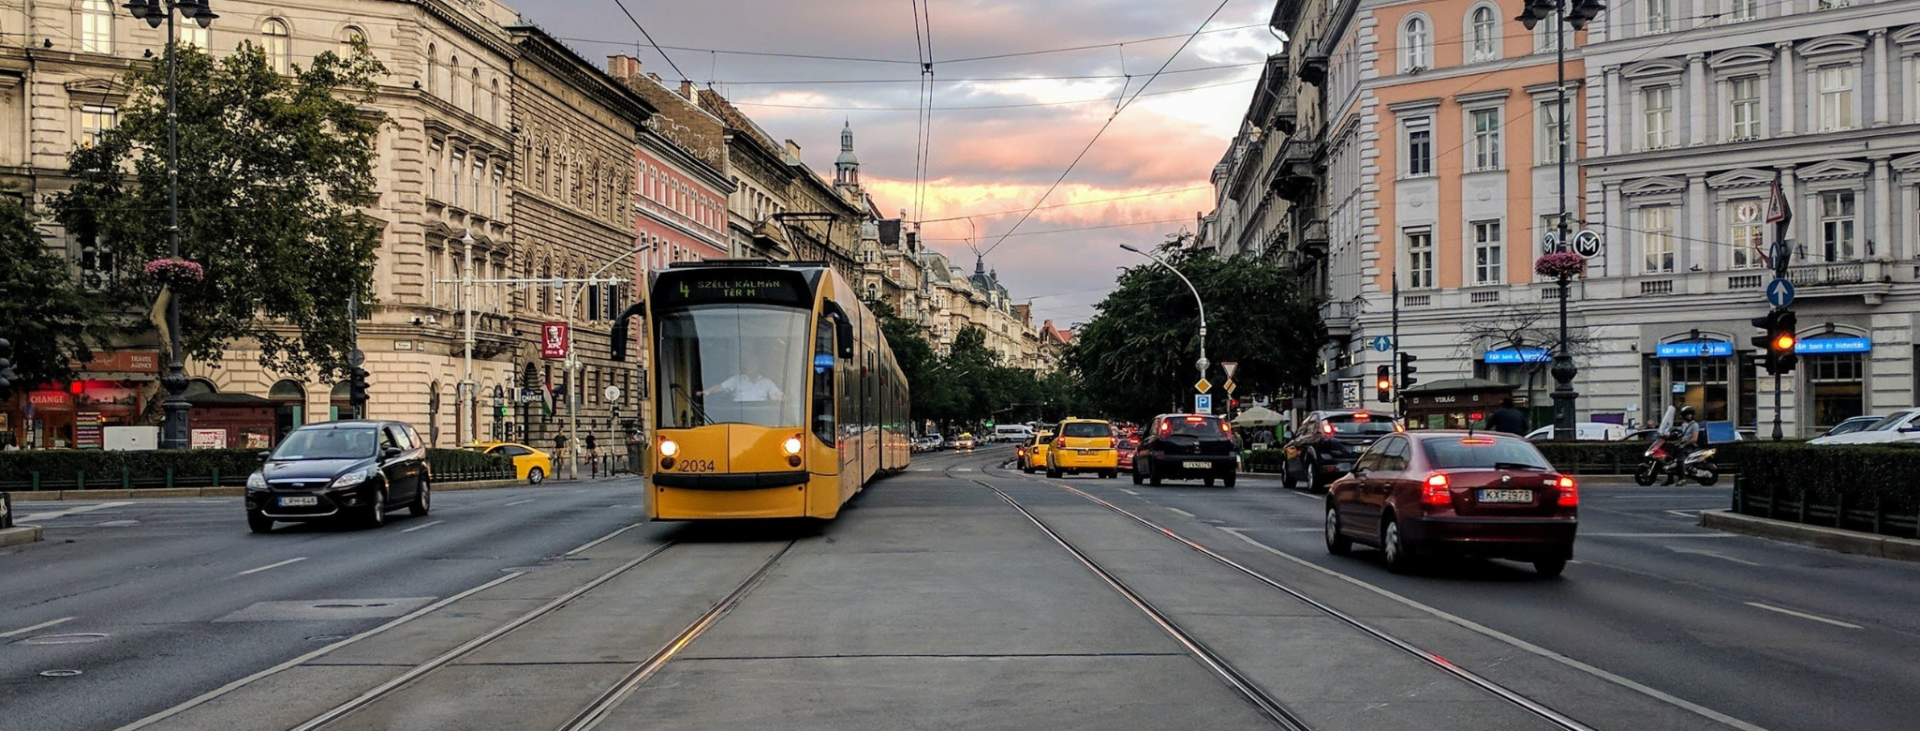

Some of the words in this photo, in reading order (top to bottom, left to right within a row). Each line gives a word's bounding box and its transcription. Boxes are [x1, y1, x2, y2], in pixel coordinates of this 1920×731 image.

[697, 280, 731, 289] SZÉLL
[735, 280, 780, 288] KÁLMÁN
[680, 281, 690, 298] 4
[724, 288, 742, 297] TÉR
[747, 289, 755, 297] M
[131, 355, 152, 363] TRAVEL
[30, 395, 64, 404] CHANGE
[1200, 397, 1208, 408] P
[1435, 395, 1456, 403] VIRÁG
[682, 459, 715, 473] 2034
